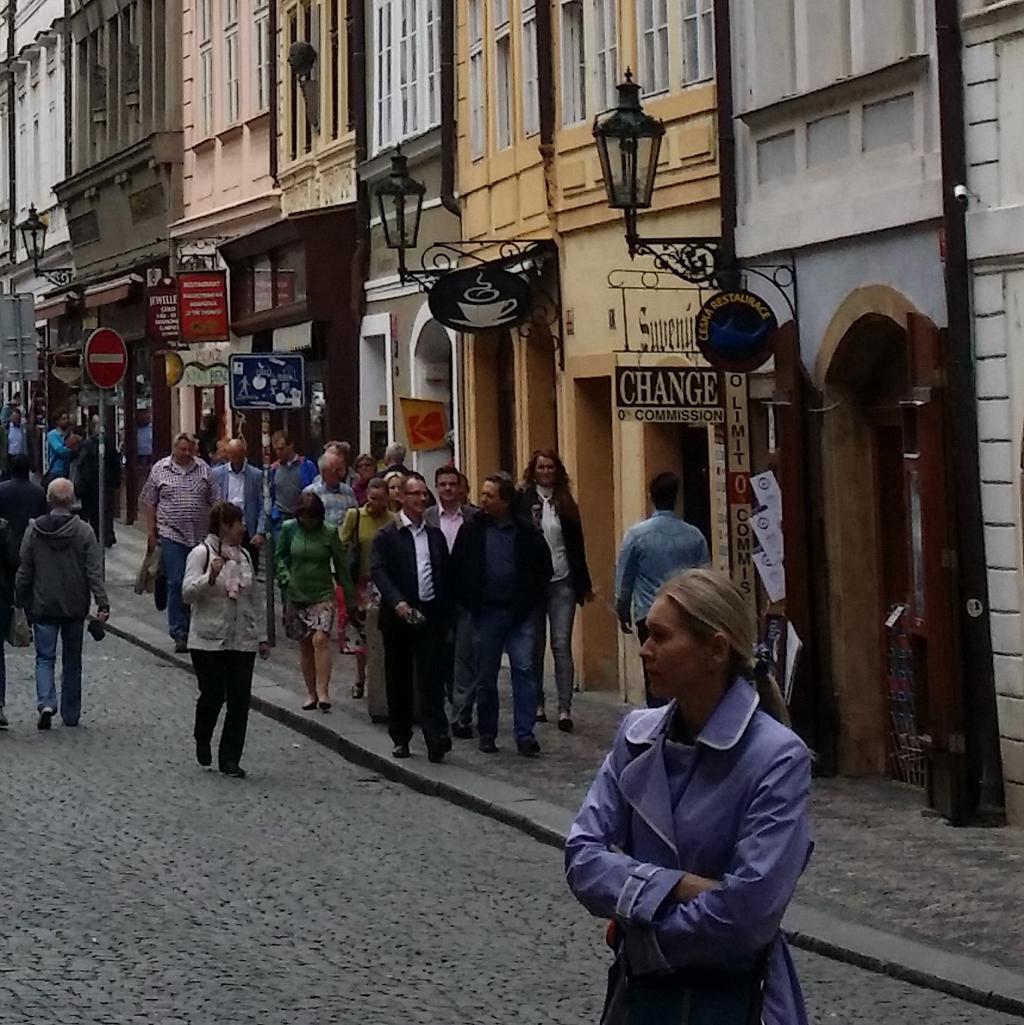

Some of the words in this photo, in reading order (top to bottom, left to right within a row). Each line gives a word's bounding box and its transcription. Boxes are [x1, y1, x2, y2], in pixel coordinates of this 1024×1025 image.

[712, 293, 771, 321] RESTAURACE
[619, 370, 718, 406] CHANGE
[635, 409, 723, 421] COMMISSION
[731, 396, 745, 466] LIMIT
